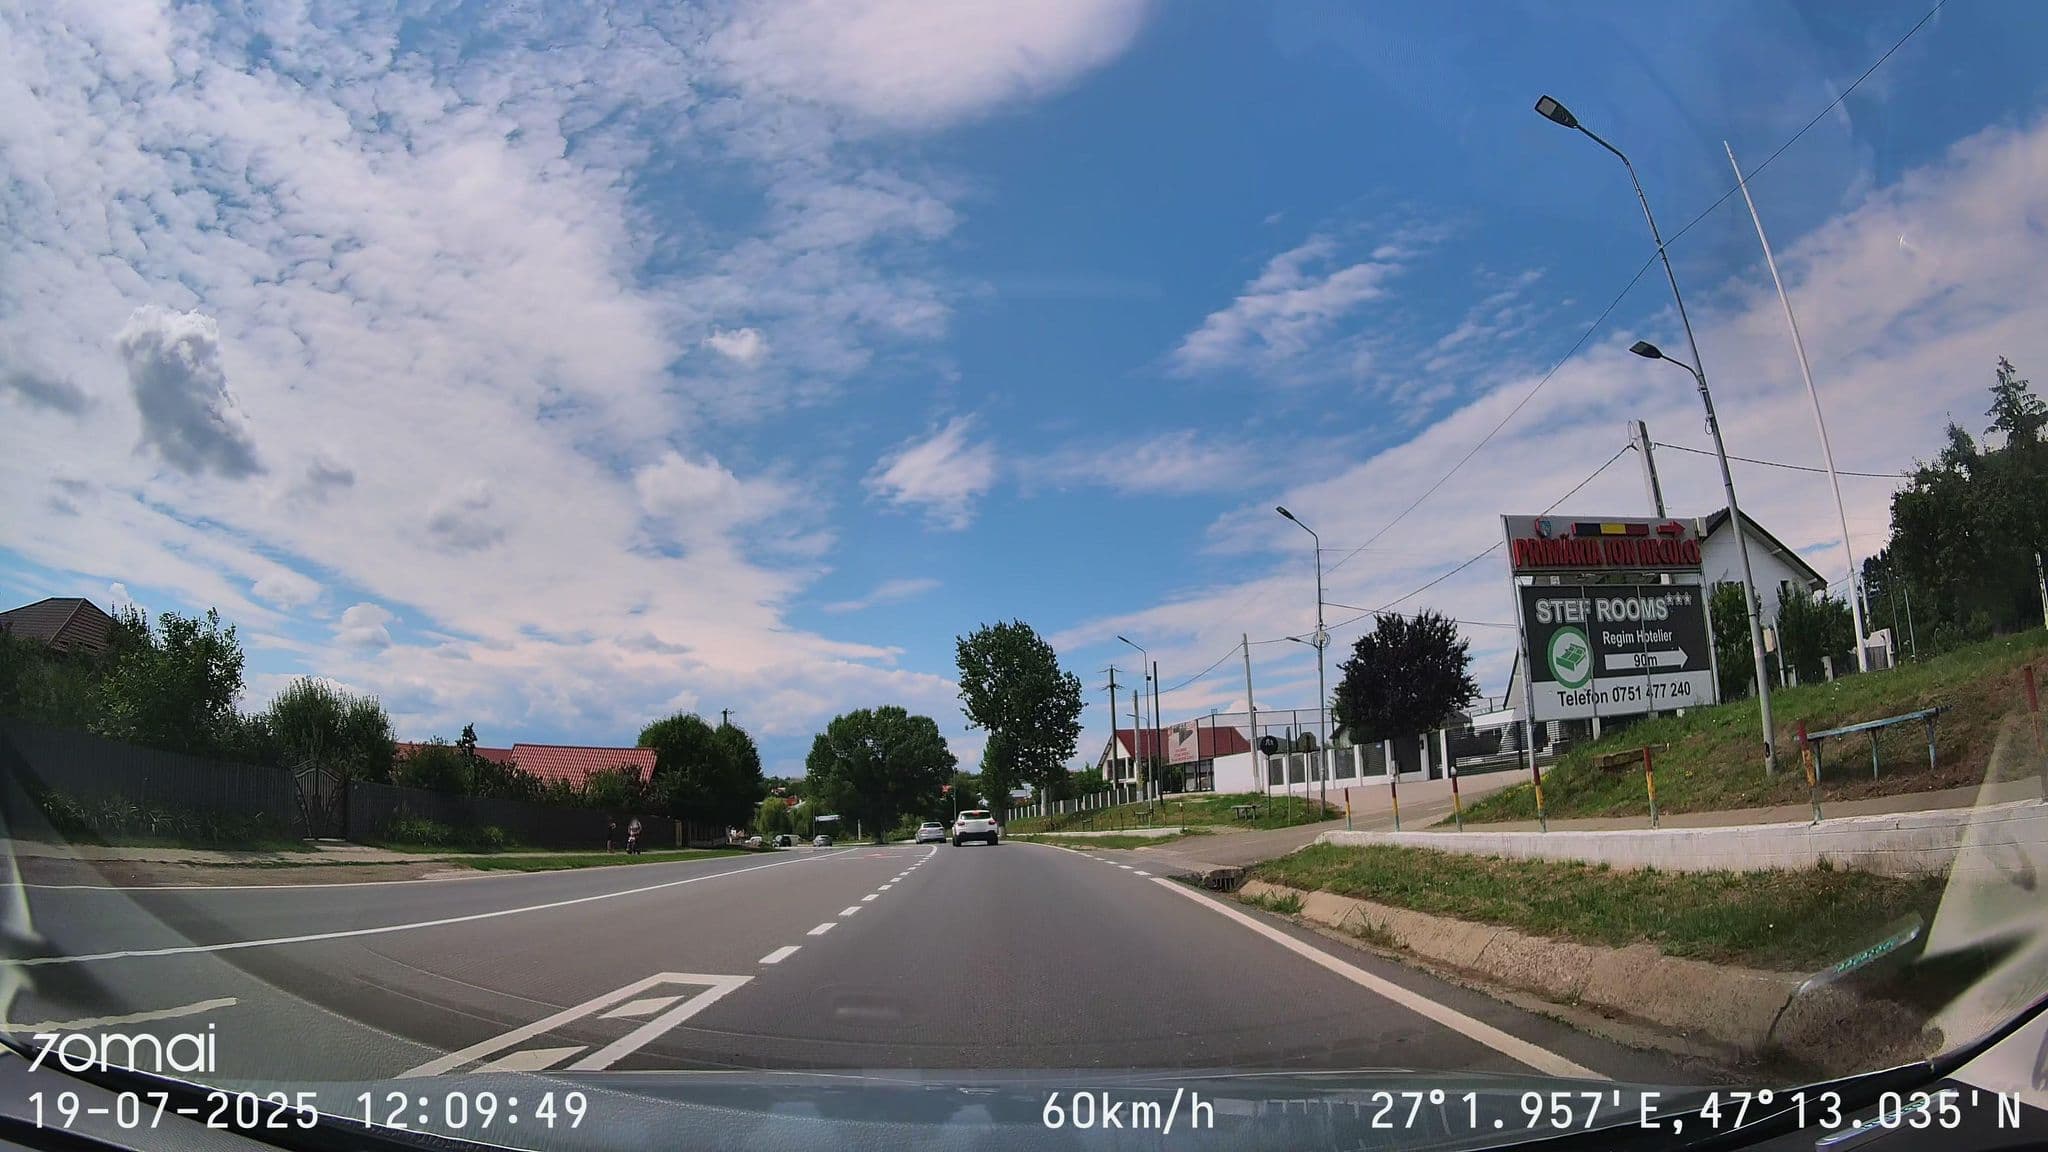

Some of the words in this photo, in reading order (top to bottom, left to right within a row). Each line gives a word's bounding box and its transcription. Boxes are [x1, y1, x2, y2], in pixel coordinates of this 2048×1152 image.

[1535, 598, 1591, 624] STEF
[1602, 630, 1635, 648] Regim
[1636, 628, 1673, 644] Hotelier
[1633, 653, 1658, 668] 90m
[1557, 689, 1609, 707] Telefon
[1612, 685, 1642, 703] 0751
[1670, 681, 1691, 697] 240
